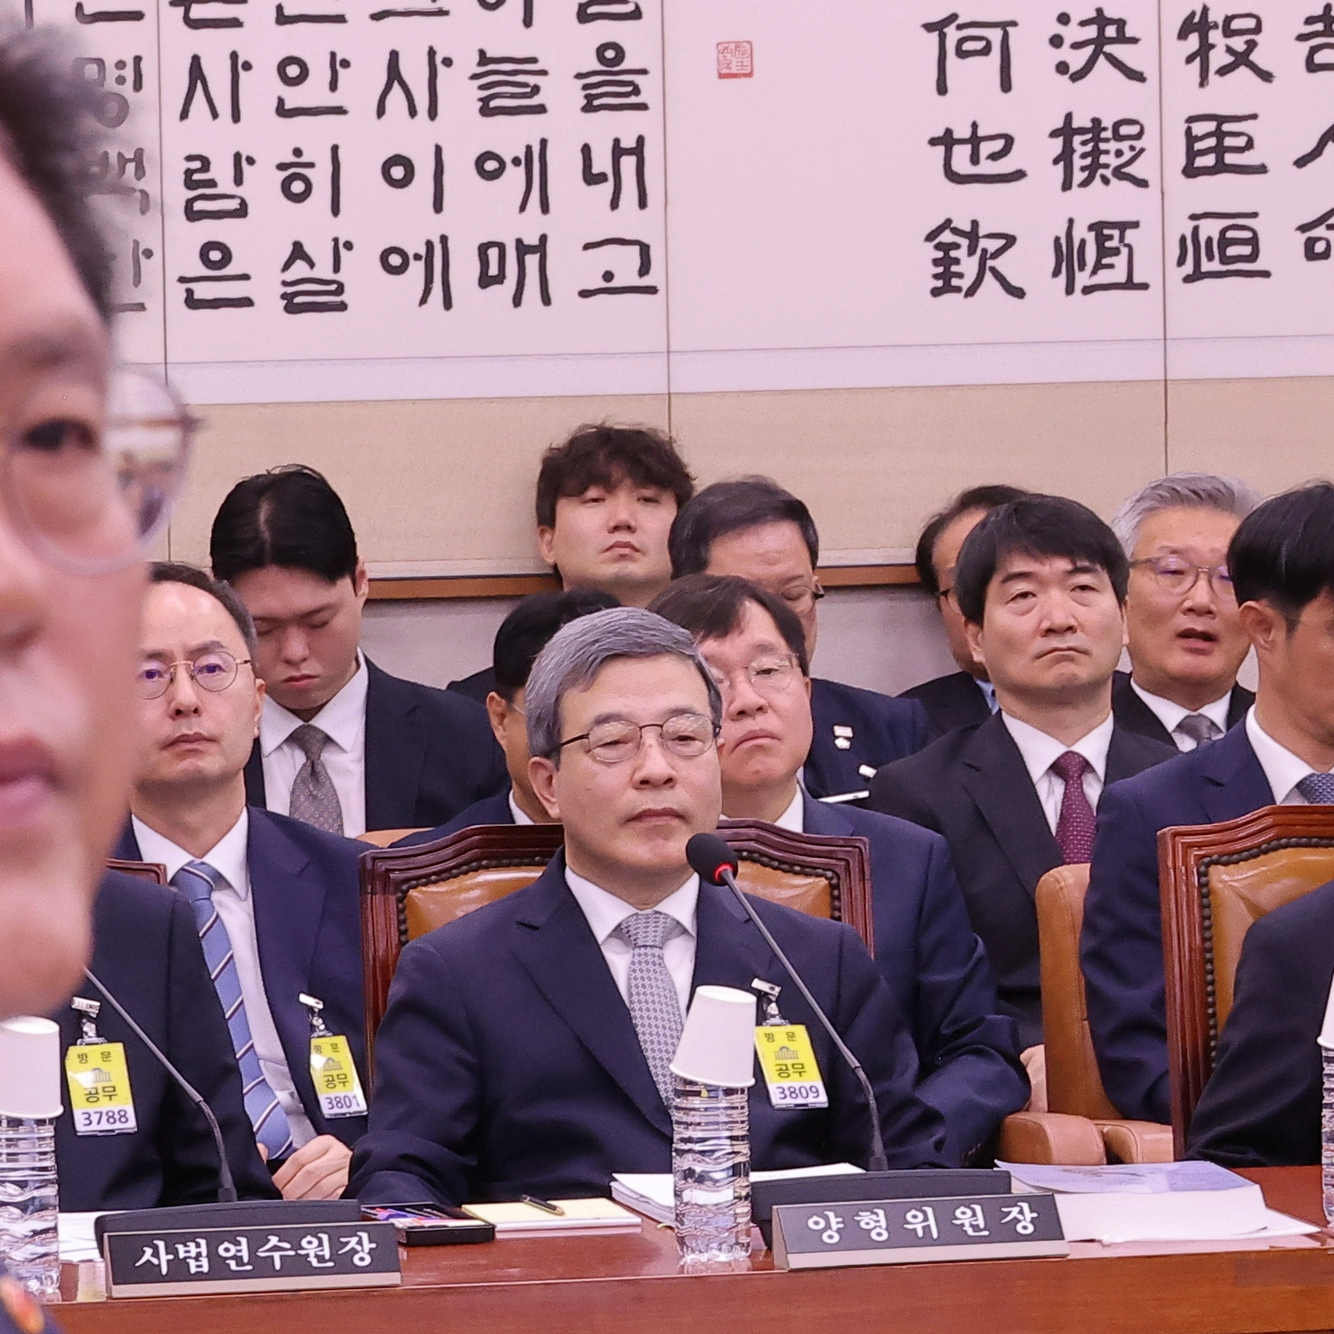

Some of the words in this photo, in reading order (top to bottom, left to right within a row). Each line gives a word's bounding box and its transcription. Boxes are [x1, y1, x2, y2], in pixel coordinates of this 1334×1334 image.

[774, 1062, 807, 1079] 공무
[323, 1072, 349, 1090] 공무
[84, 1085, 118, 1104] 공무
[775, 1085, 820, 1100] 3809
[324, 1093, 361, 1111] 3801
[81, 1108, 129, 1127] 3788
[807, 1201, 1040, 1246] 양형위원장
[133, 1231, 378, 1277] 사법연수원장
